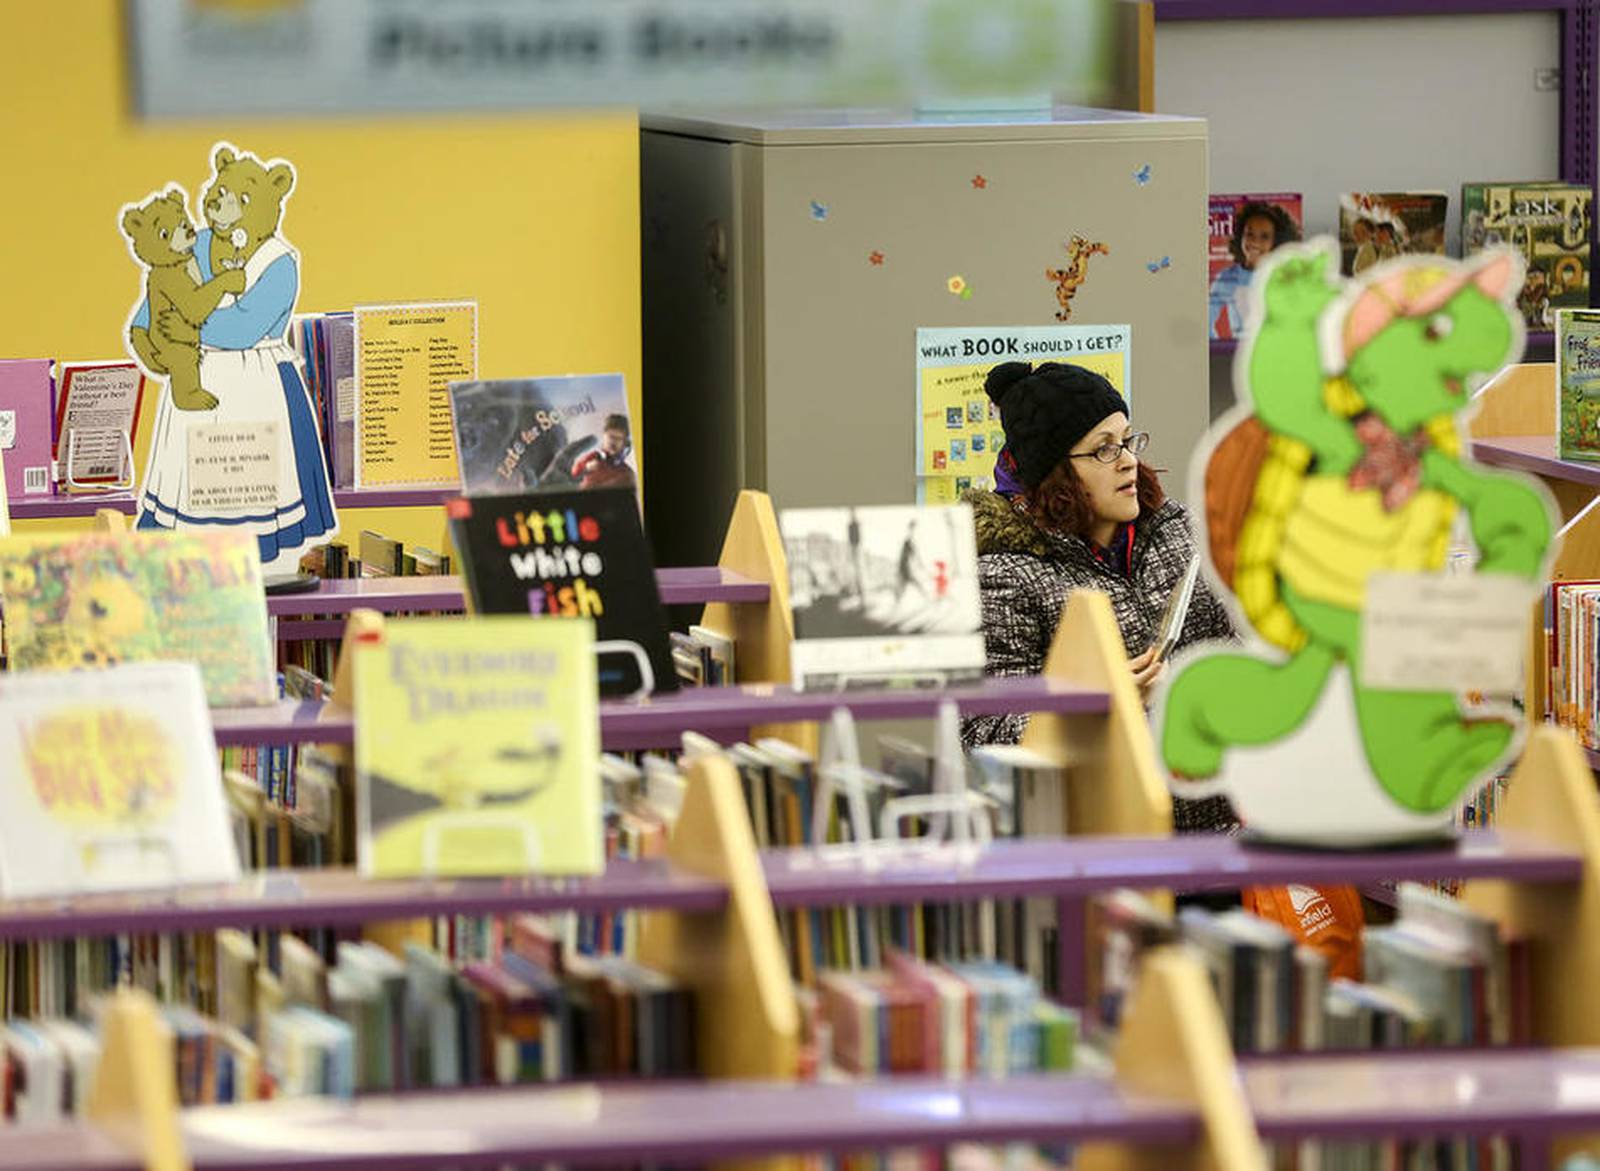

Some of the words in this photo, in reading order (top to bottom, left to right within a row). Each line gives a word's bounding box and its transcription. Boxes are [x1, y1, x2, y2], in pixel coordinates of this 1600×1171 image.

[1515, 191, 1560, 216] ask
[922, 346, 957, 358] WHAT
[962, 338, 1019, 356] BOOK
[1023, 340, 1073, 353] SHOULD
[1077, 339, 1082, 350] I
[1086, 335, 1123, 350] GET?
[496, 508, 600, 547] Little
